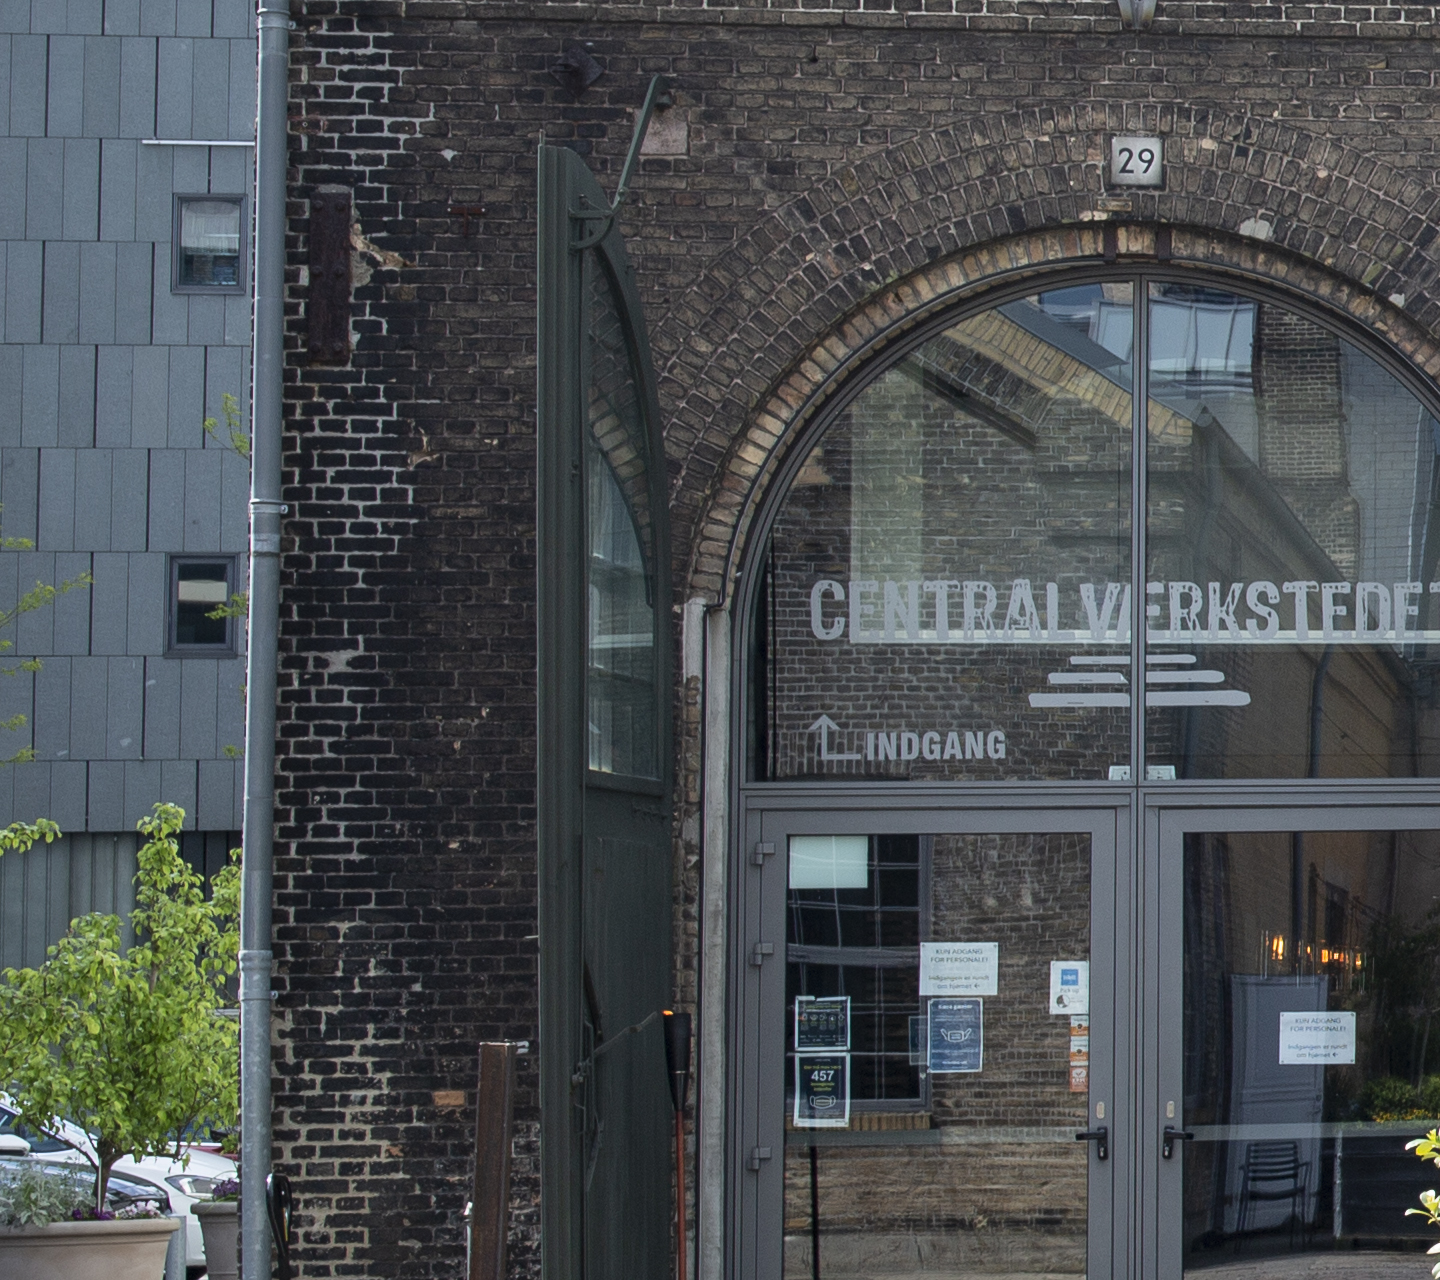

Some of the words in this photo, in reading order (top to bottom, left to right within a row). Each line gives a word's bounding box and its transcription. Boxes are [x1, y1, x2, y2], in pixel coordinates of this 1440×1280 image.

[1118, 147, 1155, 174] 29
[866, 730, 1006, 761] INDGANG
[810, 1069, 835, 1082] 457
